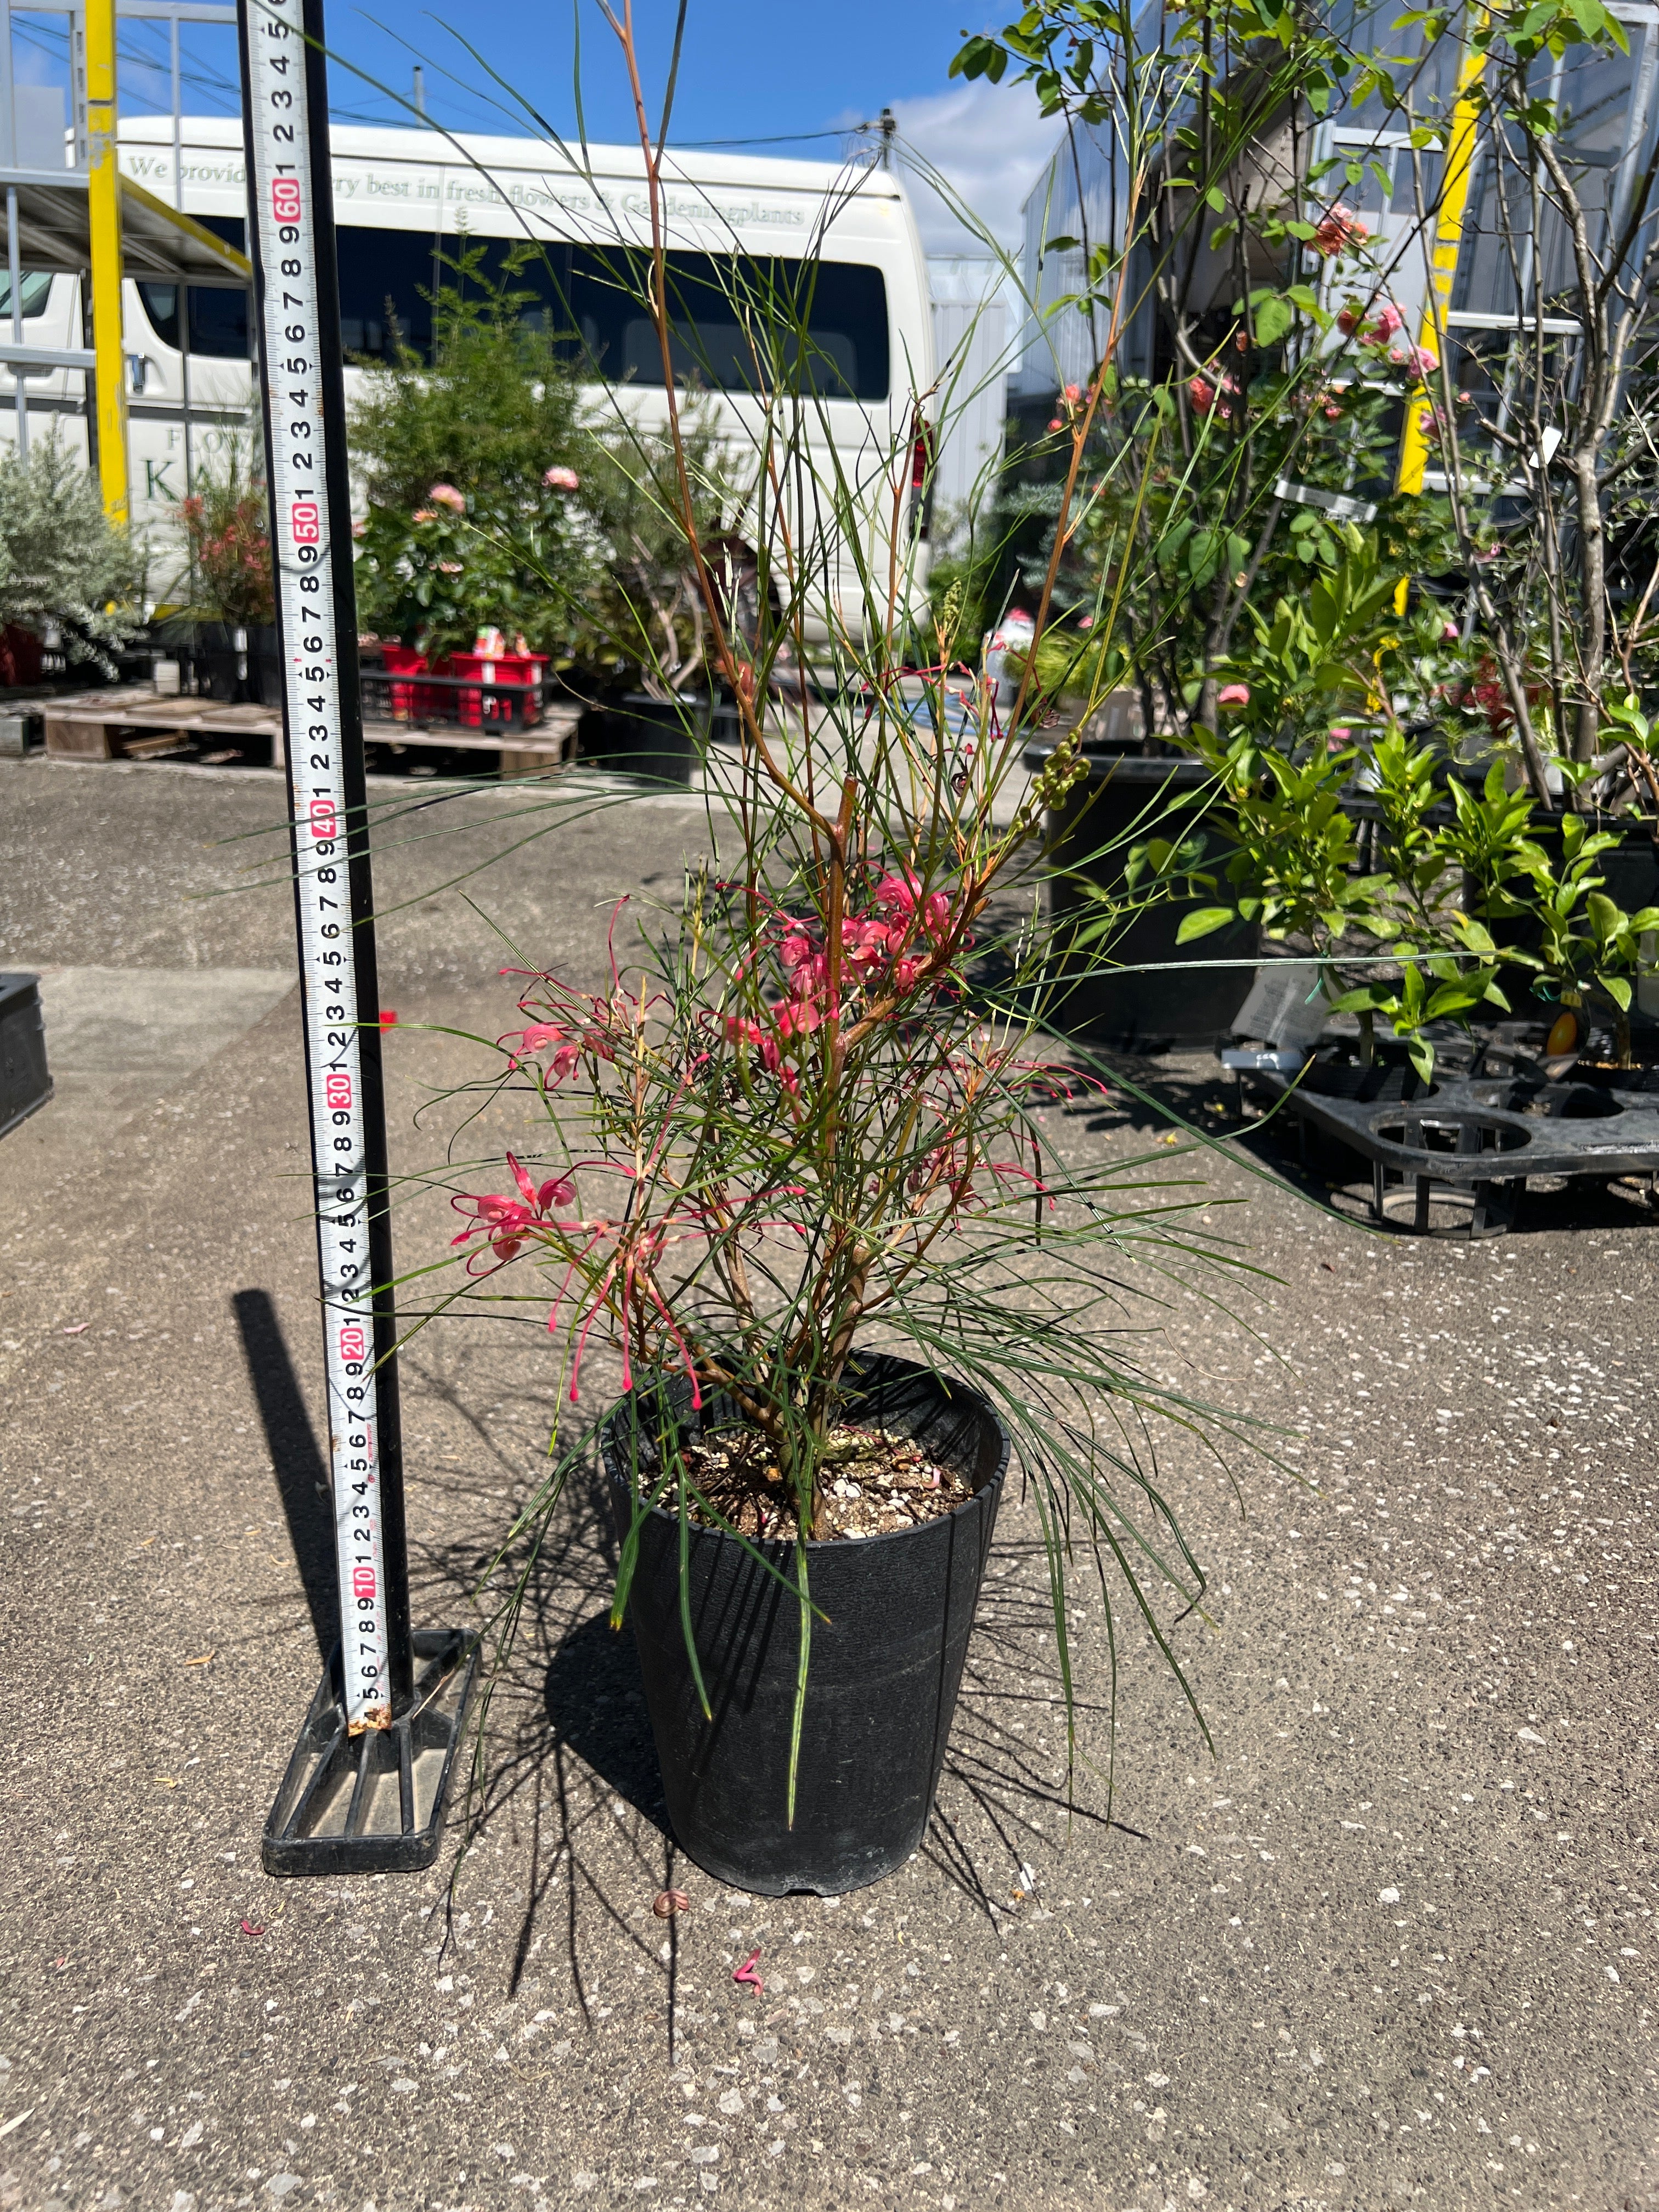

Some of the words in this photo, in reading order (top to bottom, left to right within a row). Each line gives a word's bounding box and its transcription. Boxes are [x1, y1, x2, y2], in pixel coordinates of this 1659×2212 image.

[269, 56, 290, 75] 4
[271, 91, 292, 109] 3
[273, 124, 294, 143] 2
[127, 155, 168, 178] We
[275, 164, 295, 176] 1
[366, 172, 410, 197] best
[417, 179, 440, 199] in
[446, 180, 504, 202] fresh
[508, 184, 590, 210] flowers
[595, 193, 614, 211] &
[275, 183, 300, 218] 60
[279, 226, 300, 244] 9
[281, 259, 302, 278] 8
[283, 292, 303, 310] 7
[285, 325, 305, 343] 6
[287, 358, 307, 374] 5
[289, 389, 308, 407] 4
[291, 421, 311, 439] 3
[292, 453, 312, 470] 2
[295, 489, 314, 500] 1
[294, 507, 318, 538] 50
[298, 545, 318, 563] 9
[300, 576, 319, 593] 8
[301, 606, 321, 623] 7
[303, 636, 323, 653] 6
[305, 666, 325, 682] 5
[307, 695, 326, 713] 4
[308, 725, 328, 742] 3
[310, 754, 330, 770] 2
[312, 788, 331, 798] 1
[311, 804, 335, 833] 40
[316, 839, 334, 855] 9
[317, 868, 336, 884] 8
[319, 896, 338, 911] 7
[321, 923, 340, 939] 6
[323, 951, 341, 966] 5
[324, 978, 342, 994] 4
[326, 1005, 345, 1020] 3
[328, 1032, 347, 1047] 2
[330, 1063, 347, 1071] 1
[328, 1077, 351, 1104] 30
[332, 1111, 351, 1126] 9
[334, 1137, 352, 1152] 8
[335, 1163, 353, 1177] 7
[336, 1188, 354, 1202] 6
[338, 1214, 356, 1227] 5
[339, 1239, 357, 1253] 4
[340, 1264, 359, 1279] 3
[343, 1318, 360, 1326] 1
[341, 1330, 363, 1357] 20
[345, 1362, 363, 1376] 9
[346, 1386, 365, 1401] 8
[348, 1410, 365, 1424] 7
[349, 1435, 366, 1448] 6
[351, 1458, 368, 1471] 5
[352, 1481, 368, 1496] 4
[352, 1505, 370, 1519] 3
[354, 1528, 371, 1542] 2
[354, 1554, 372, 1563] 1
[355, 1570, 376, 1593] 10
[357, 1597, 374, 1610] 9
[359, 1620, 375, 1633] 8
[360, 1643, 376, 1655] 7
[361, 1665, 378, 1678] 6
[363, 1687, 379, 1700] 5
